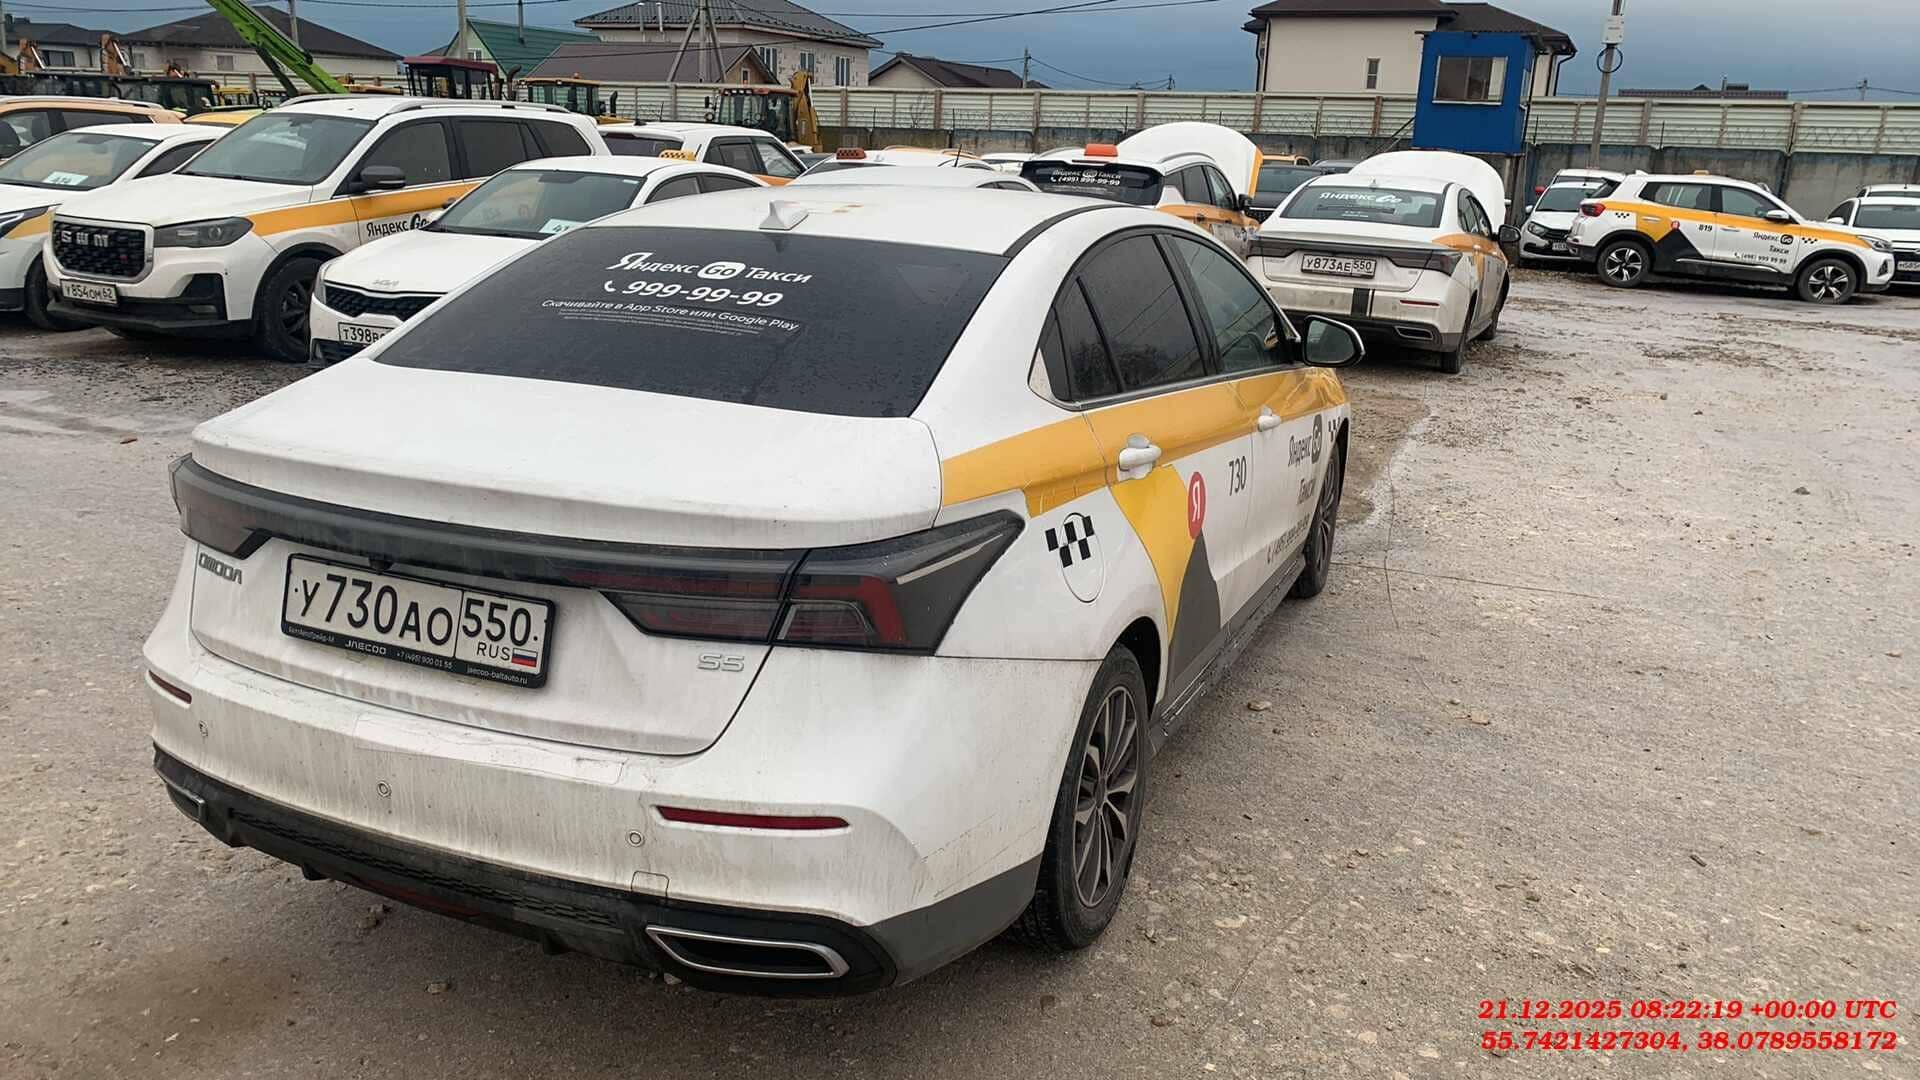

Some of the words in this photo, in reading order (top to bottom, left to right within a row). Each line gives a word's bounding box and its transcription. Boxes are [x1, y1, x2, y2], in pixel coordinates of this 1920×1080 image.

[366, 220, 409, 237] Яндекс
[1752, 231, 1779, 241] Яндекс
[1769, 245, 1790, 254] Такси
[605, 252, 699, 273] Яндекс
[745, 267, 813, 283] Такси
[622, 280, 783, 306] 999-99-99
[542, 299, 613, 309] Скачивайте
[622, 303, 651, 312] App
[652, 305, 688, 315] Store
[689, 309, 716, 318] или
[718, 312, 768, 325] Google
[769, 319, 799, 331] Play
[1228, 456, 1247, 496] 730
[199, 552, 242, 584] OMODA
[301, 573, 453, 646] У730АО
[462, 598, 531, 647] 550
[345, 639, 387, 655] JAECOO
[476, 641, 511, 661] RUS
[698, 653, 745, 672] S5
